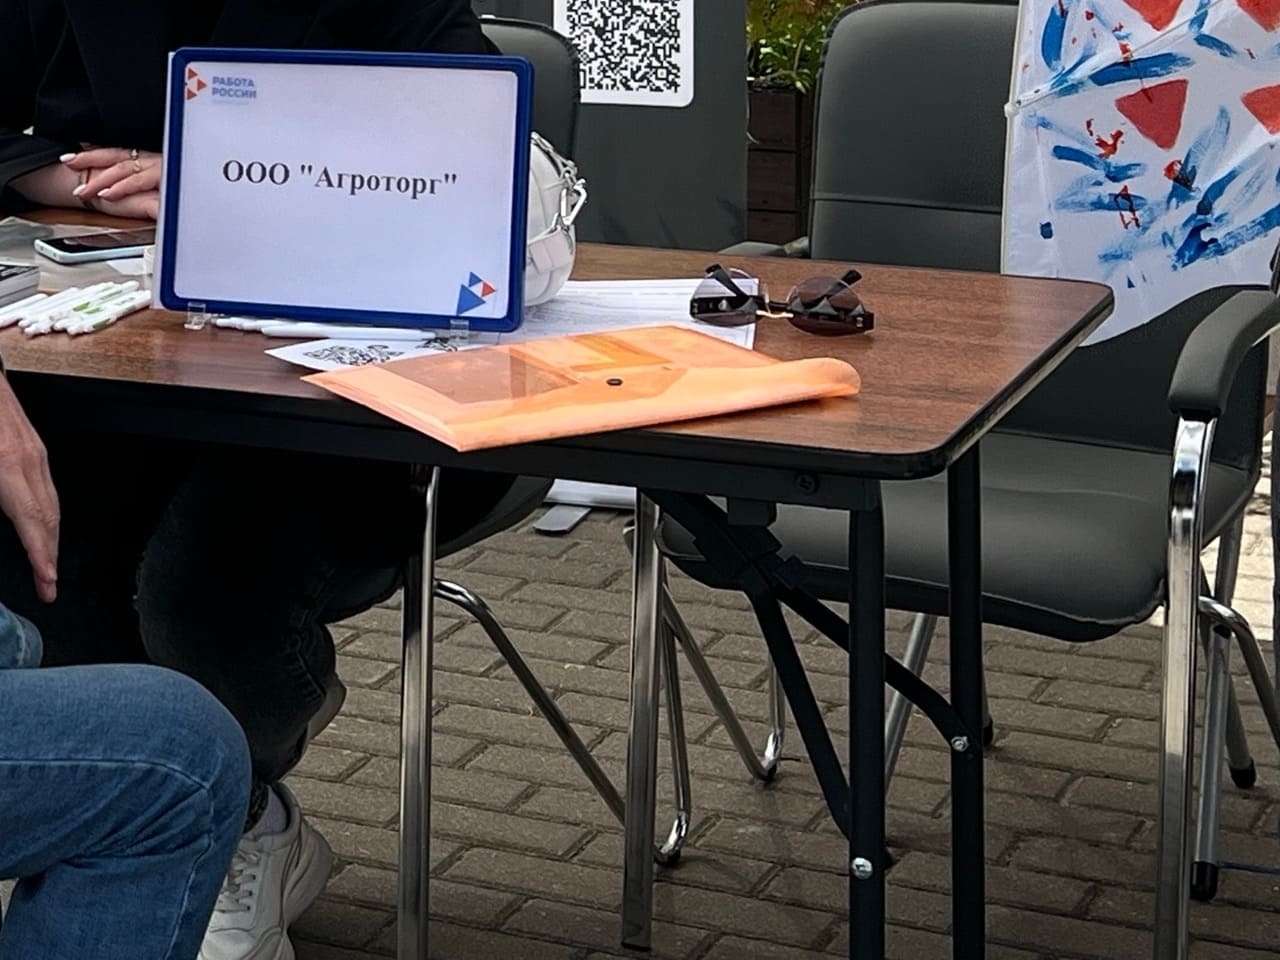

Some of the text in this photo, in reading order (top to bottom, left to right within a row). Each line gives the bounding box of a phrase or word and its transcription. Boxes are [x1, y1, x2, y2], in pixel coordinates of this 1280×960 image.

[212, 76, 255, 88] РАБОТА
[211, 87, 257, 99] РОССИИ
[222, 159, 458, 200] ООО "Агроторг"
